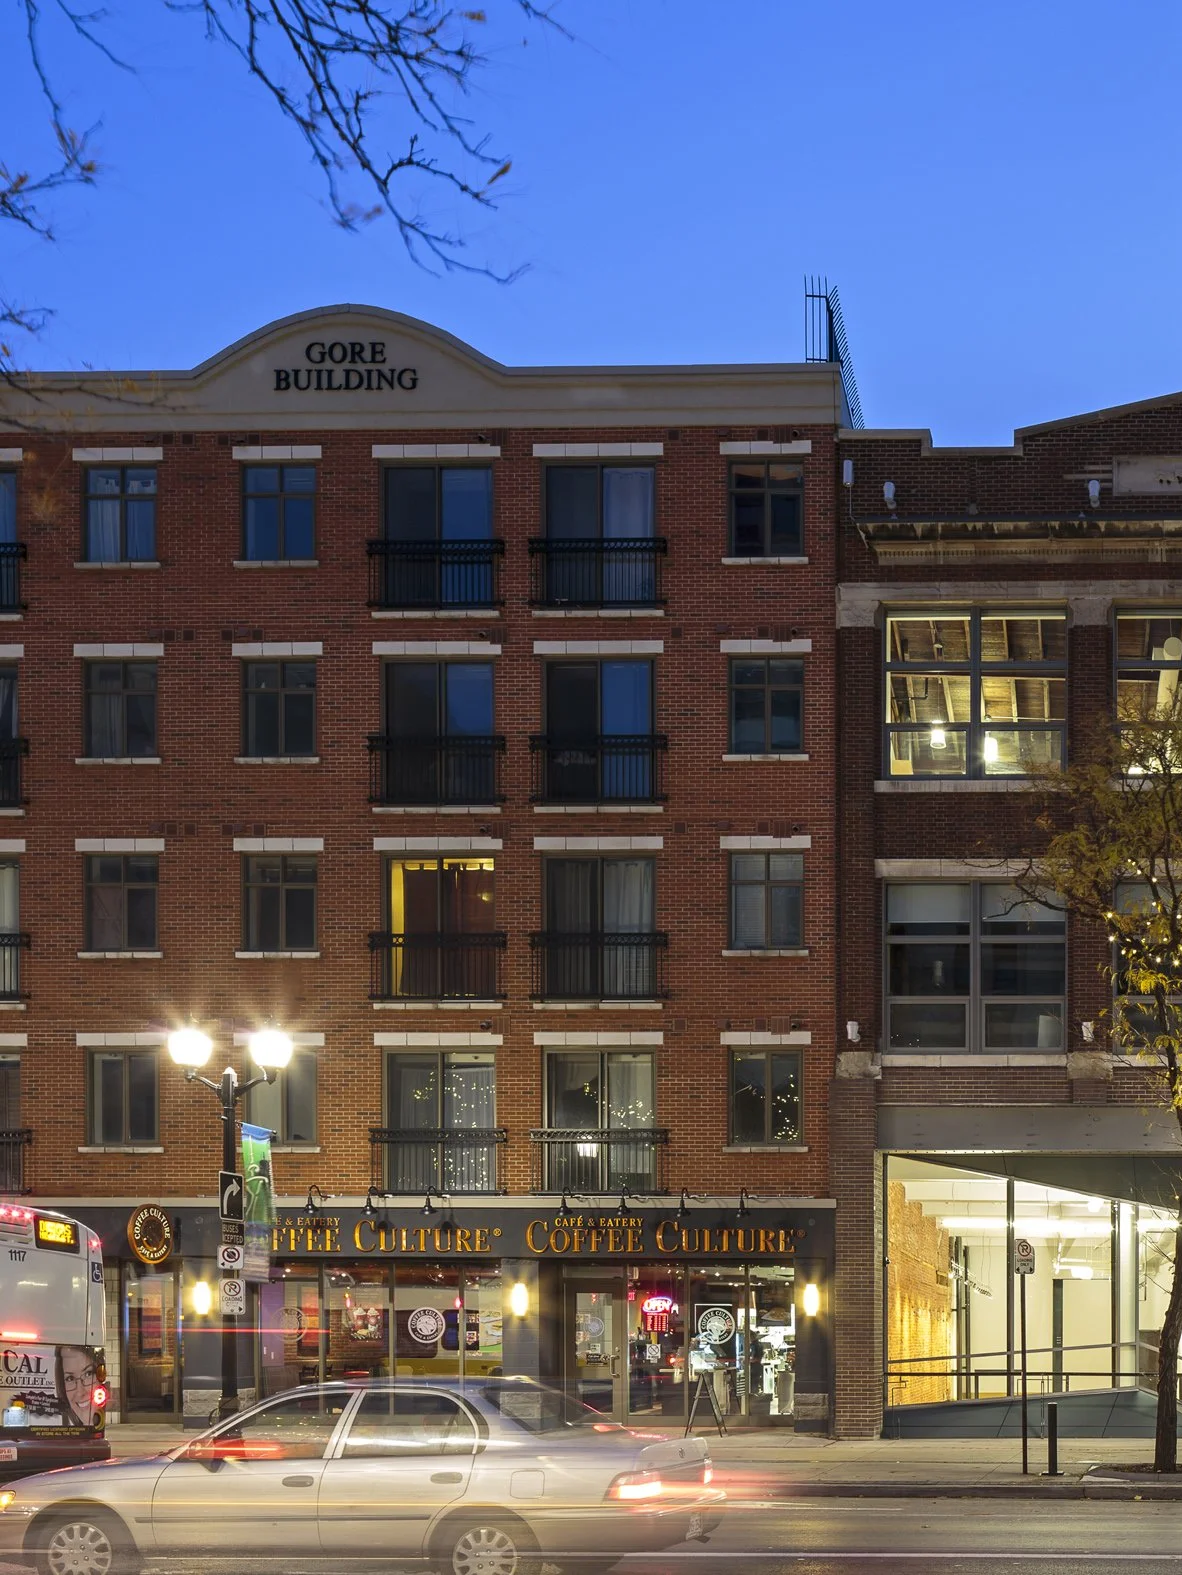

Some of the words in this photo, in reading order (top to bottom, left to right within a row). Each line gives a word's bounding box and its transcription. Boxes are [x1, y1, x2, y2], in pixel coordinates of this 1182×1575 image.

[305, 342, 387, 364] GORE
[273, 368, 419, 391] BUILDING
[134, 1209, 150, 1240] COFFEE
[149, 1208, 171, 1239] CULTURE
[297, 1217, 340, 1226] EATERY
[555, 1216, 583, 1227] CAFÉ
[588, 1219, 595, 1227] &
[600, 1219, 644, 1227] EATERY
[525, 1220, 644, 1253] COFFEE
[8, 1249, 27, 1262] 1117
[645, 1298, 671, 1311] OPEN
[5, 1376, 46, 1386] OUTLET
